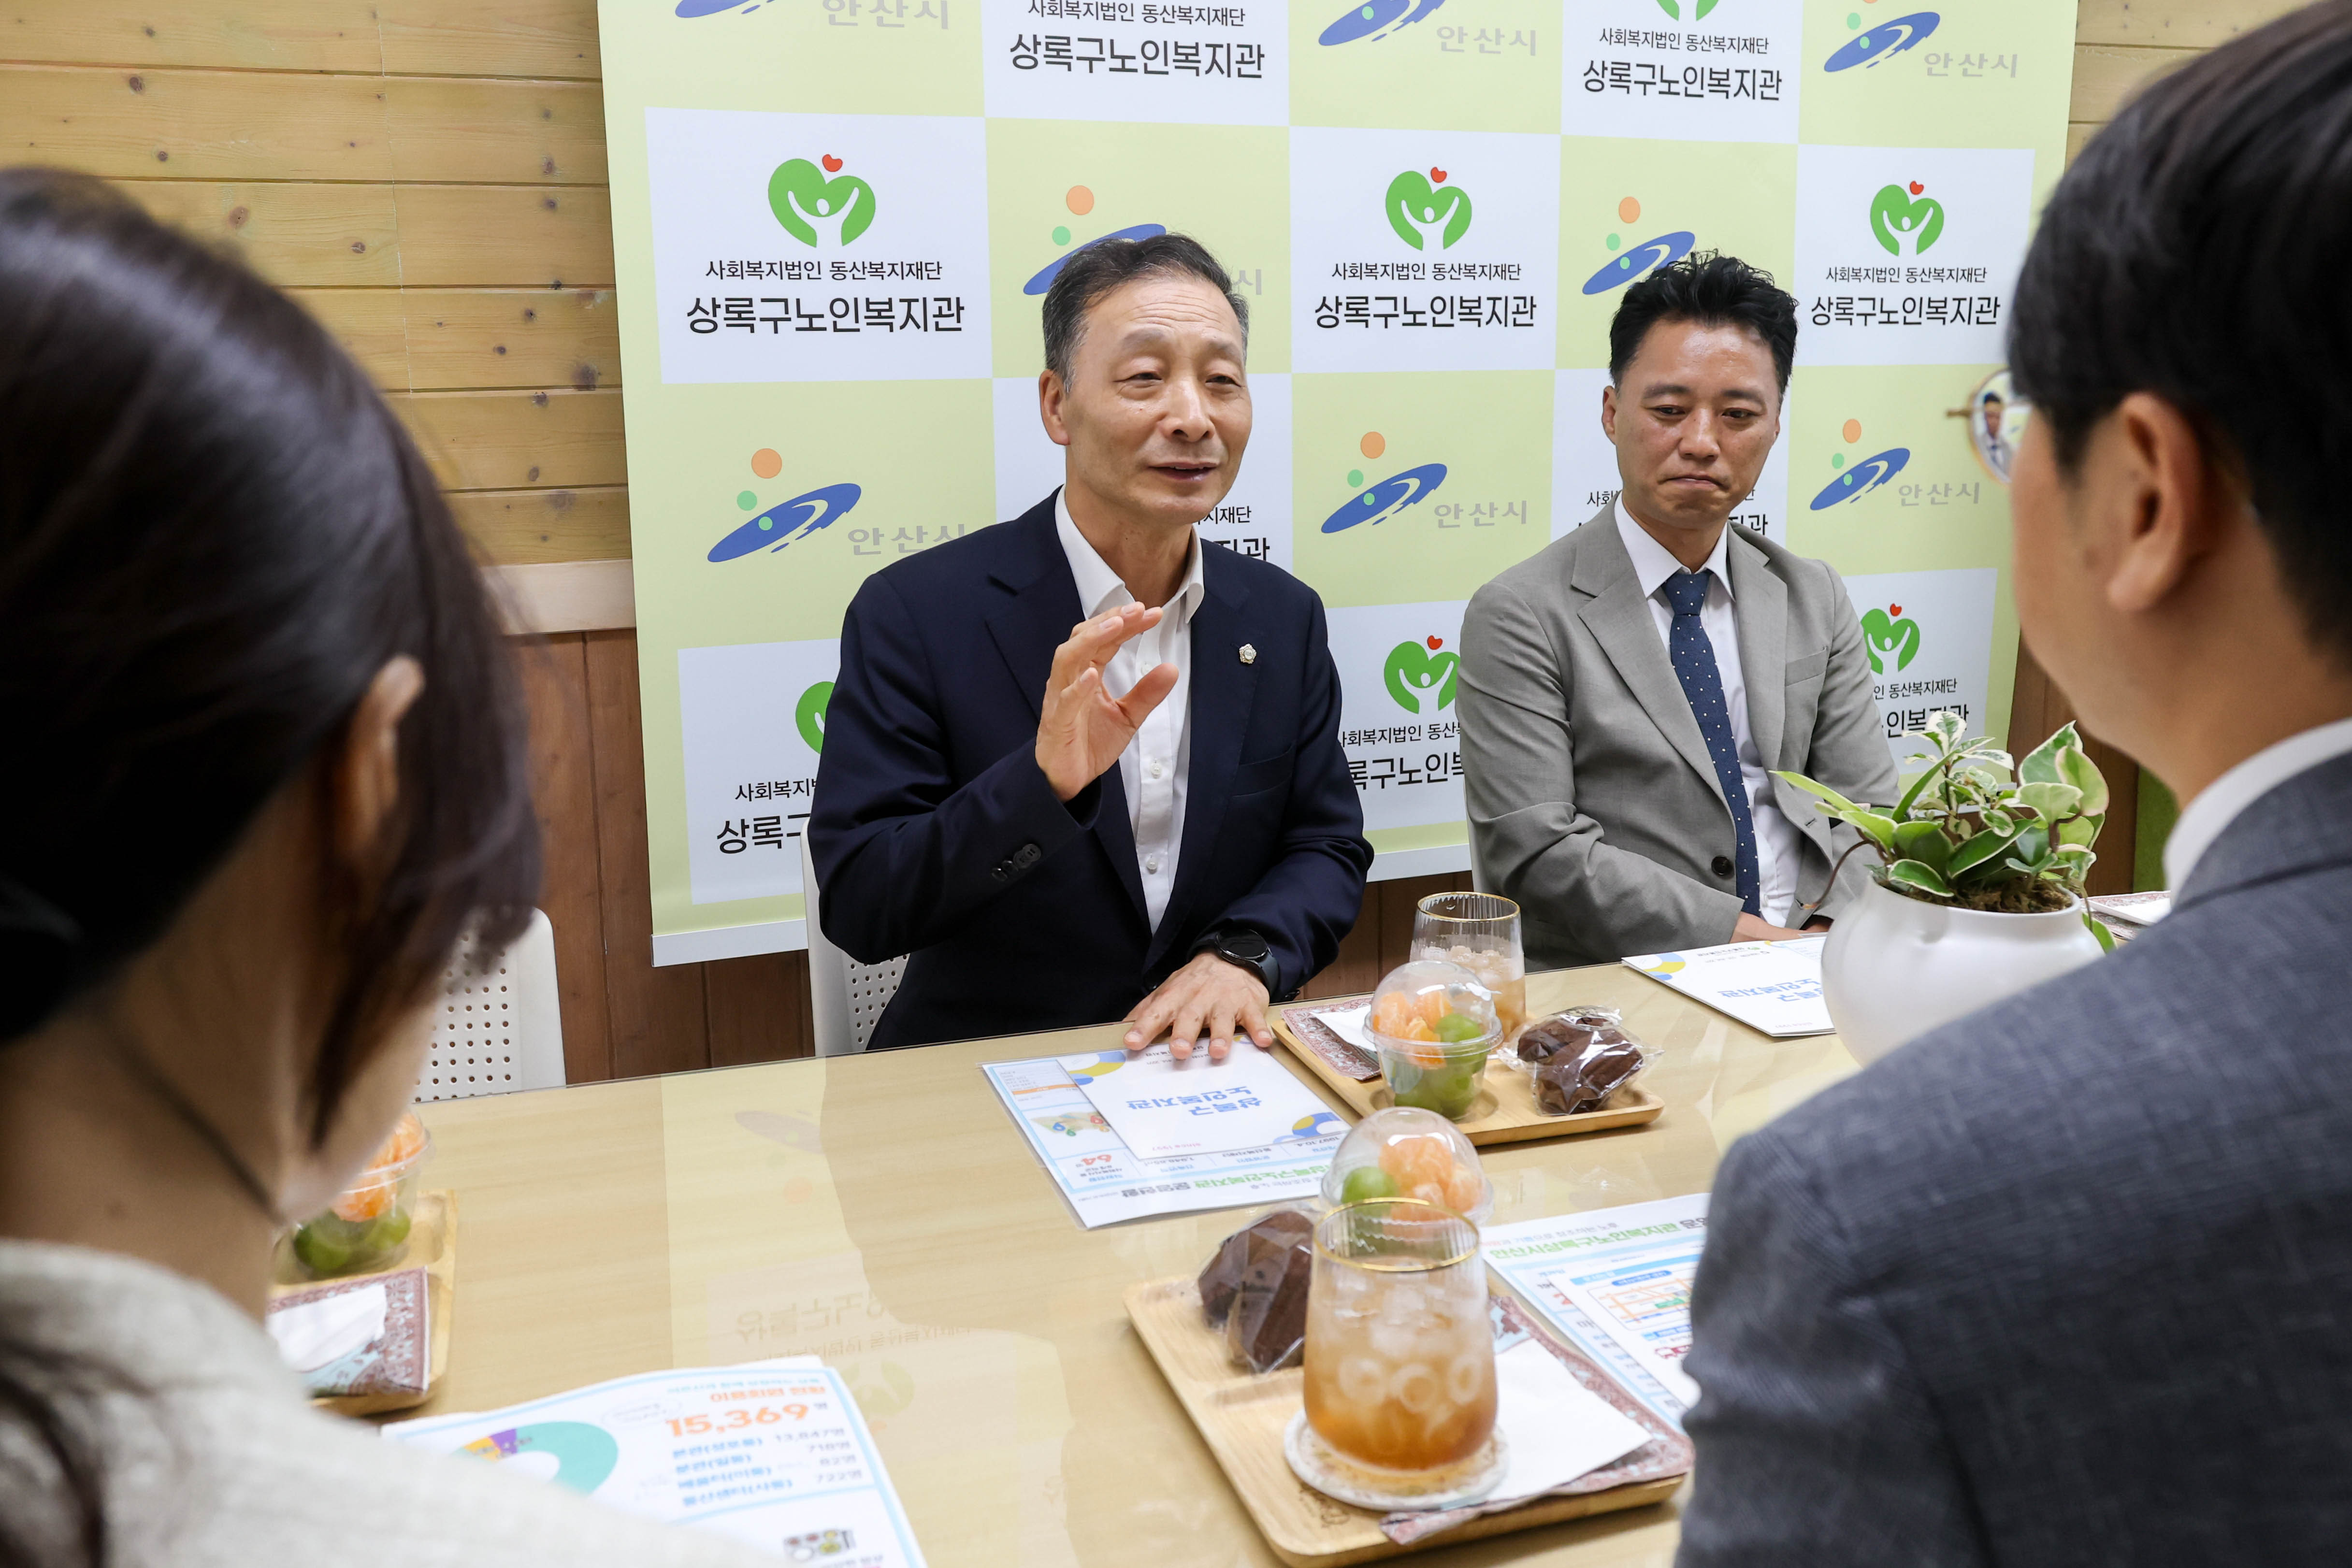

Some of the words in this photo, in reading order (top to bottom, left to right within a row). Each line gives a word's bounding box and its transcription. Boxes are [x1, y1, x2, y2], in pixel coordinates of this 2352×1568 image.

[822, 0, 949, 29] 안산시
[1028, 0, 1134, 22] 사회복지법인
[1141, 4, 1246, 27] 동산복지재단
[1436, 26, 1536, 56] 안산시
[1599, 28, 1680, 50] 사회복지법인
[1686, 34, 1769, 54] 동산복지재단
[1010, 34, 1265, 79] 상록구노인복지관
[1923, 53, 2018, 78] 안산시
[1583, 60, 1782, 101] 상록구노인복지관
[705, 260, 822, 280] 사회복지법인
[829, 261, 943, 281] 동산복지재단
[1331, 262, 1426, 280] 사회복지법인
[1431, 263, 1522, 281] 동산복지재단
[1826, 266, 1900, 283] 사회복지법인
[1905, 267, 1988, 284] 동산복지재단
[687, 297, 965, 334] 상록구노인복지관
[1314, 295, 1537, 329] 상록구노인복지관
[1811, 296, 2001, 327] 상록구노인복지관
[1898, 482, 1980, 506] 안산시
[1434, 500, 1527, 528] 안산시
[848, 524, 965, 555] 안산시
[1889, 678, 1957, 699] 동산복지재단
[1348, 752, 1464, 790] 록구노인
[735, 778, 817, 802] 사회복지
[1717, 978, 1821, 998] 노인복지관
[1126, 1086, 1252, 1109] 노인복지관
[1188, 1097, 1262, 1116] 상록구
[1081, 1154, 1112, 1165] 64
[1489, 1223, 1682, 1259] 안산시상록구노인복지관
[666, 1403, 809, 1438] 15,369
